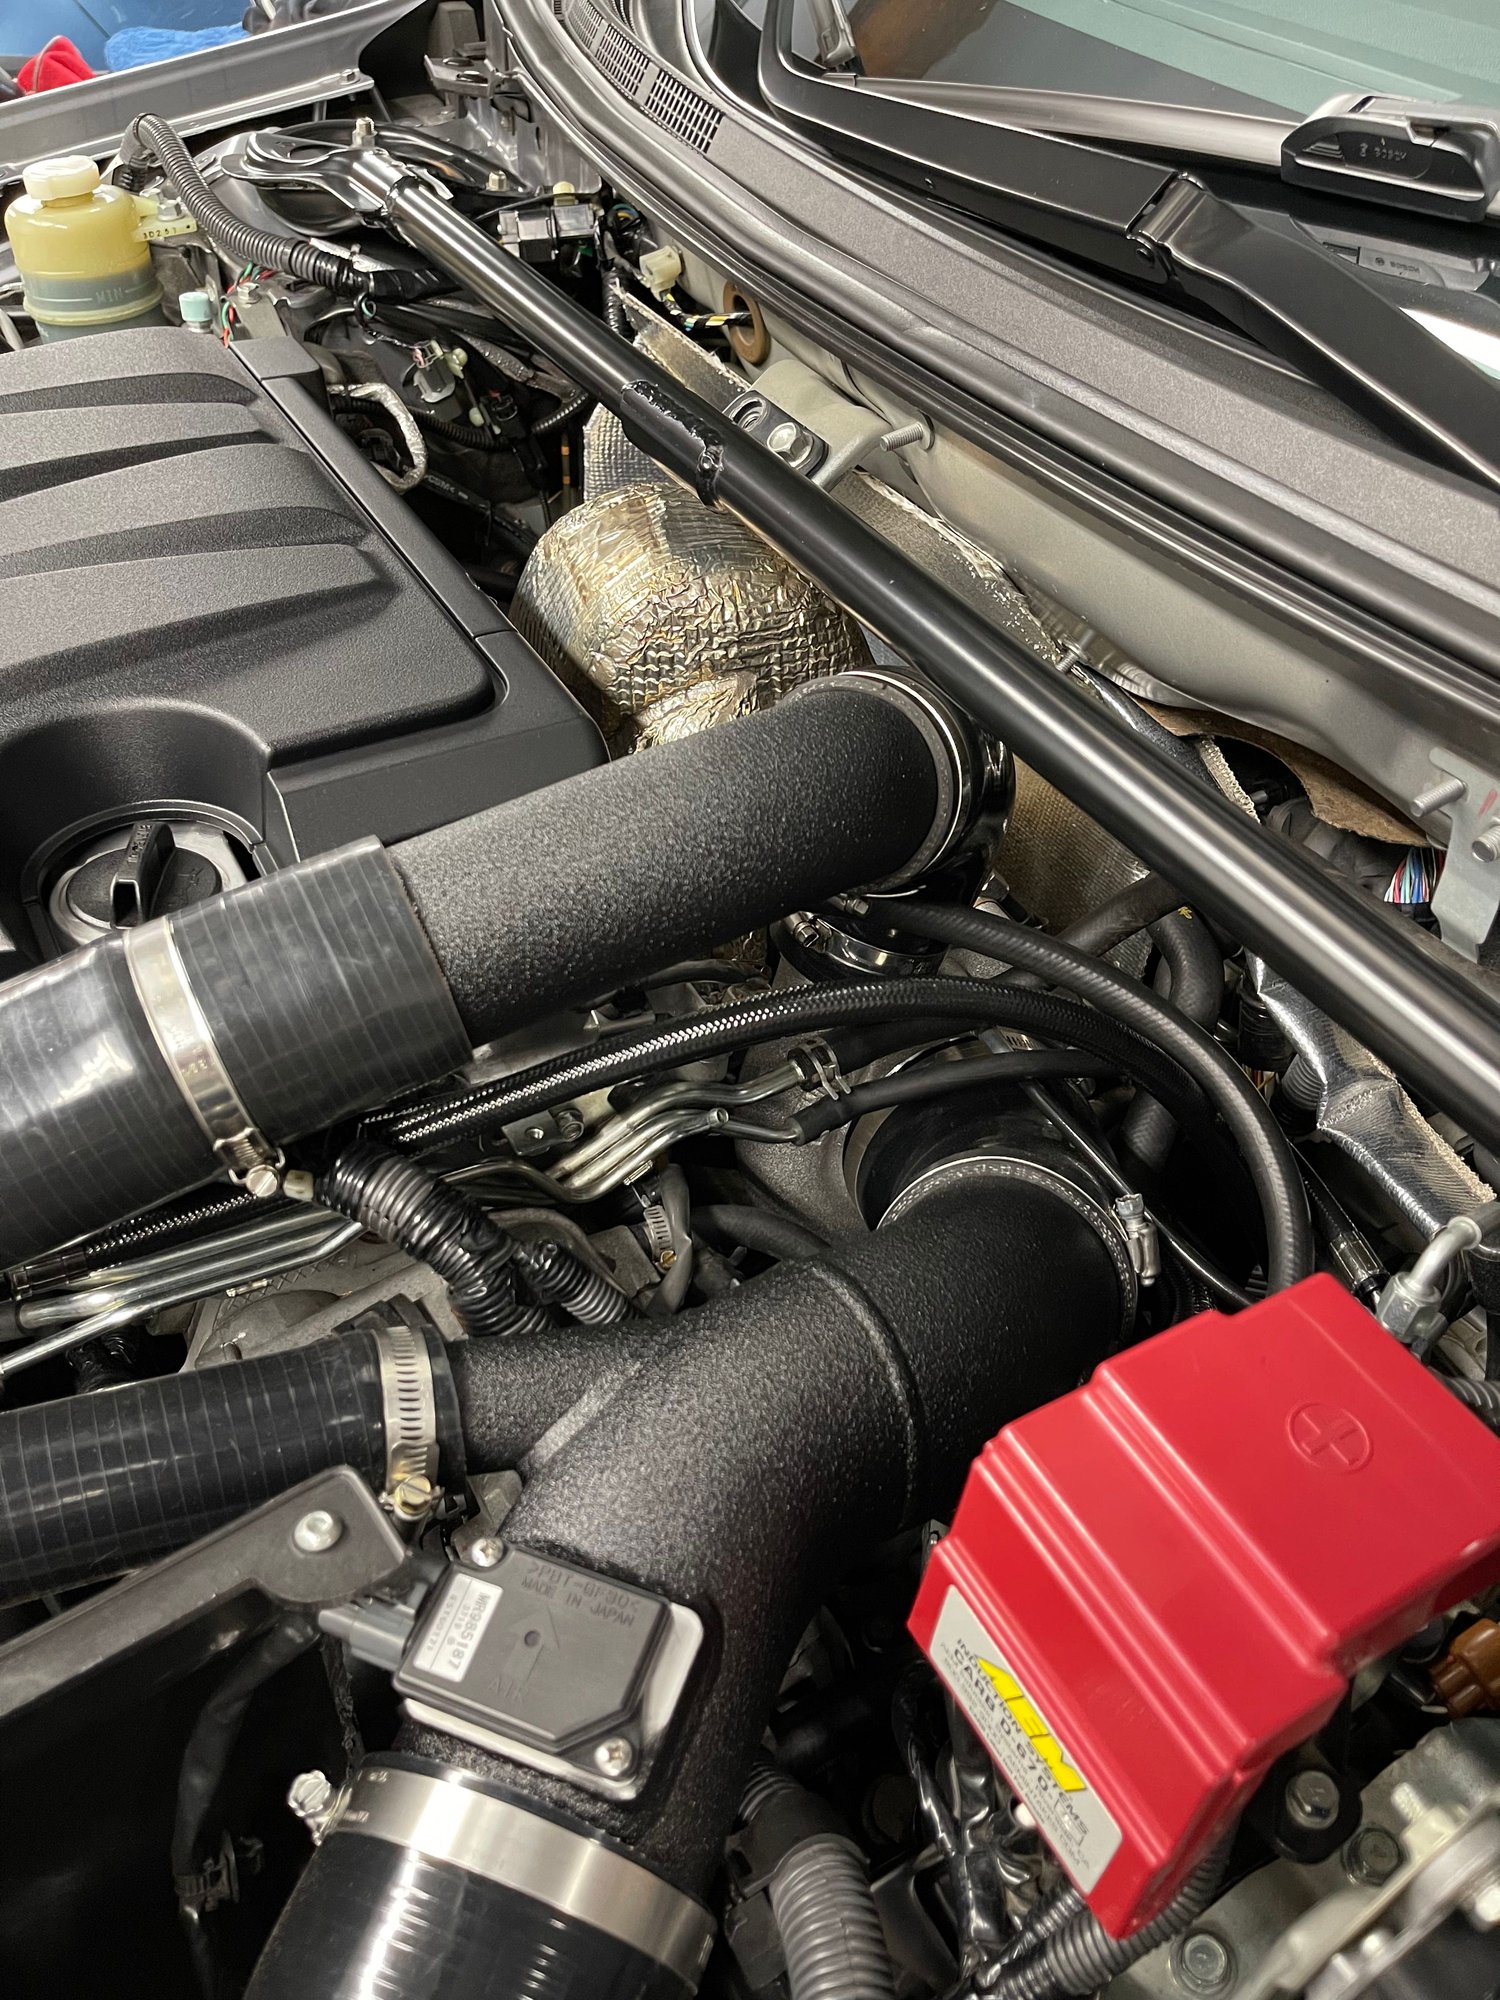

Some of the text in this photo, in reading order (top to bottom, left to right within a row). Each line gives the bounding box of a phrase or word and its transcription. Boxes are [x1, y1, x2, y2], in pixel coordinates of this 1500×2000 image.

[521, 1576, 635, 1627] MADE IN JAPAN
[953, 1646, 995, 1712] CARB
[977, 1658, 1087, 1792] AEM
[956, 1637, 1088, 1836] INDUCTION SYSTEMS
